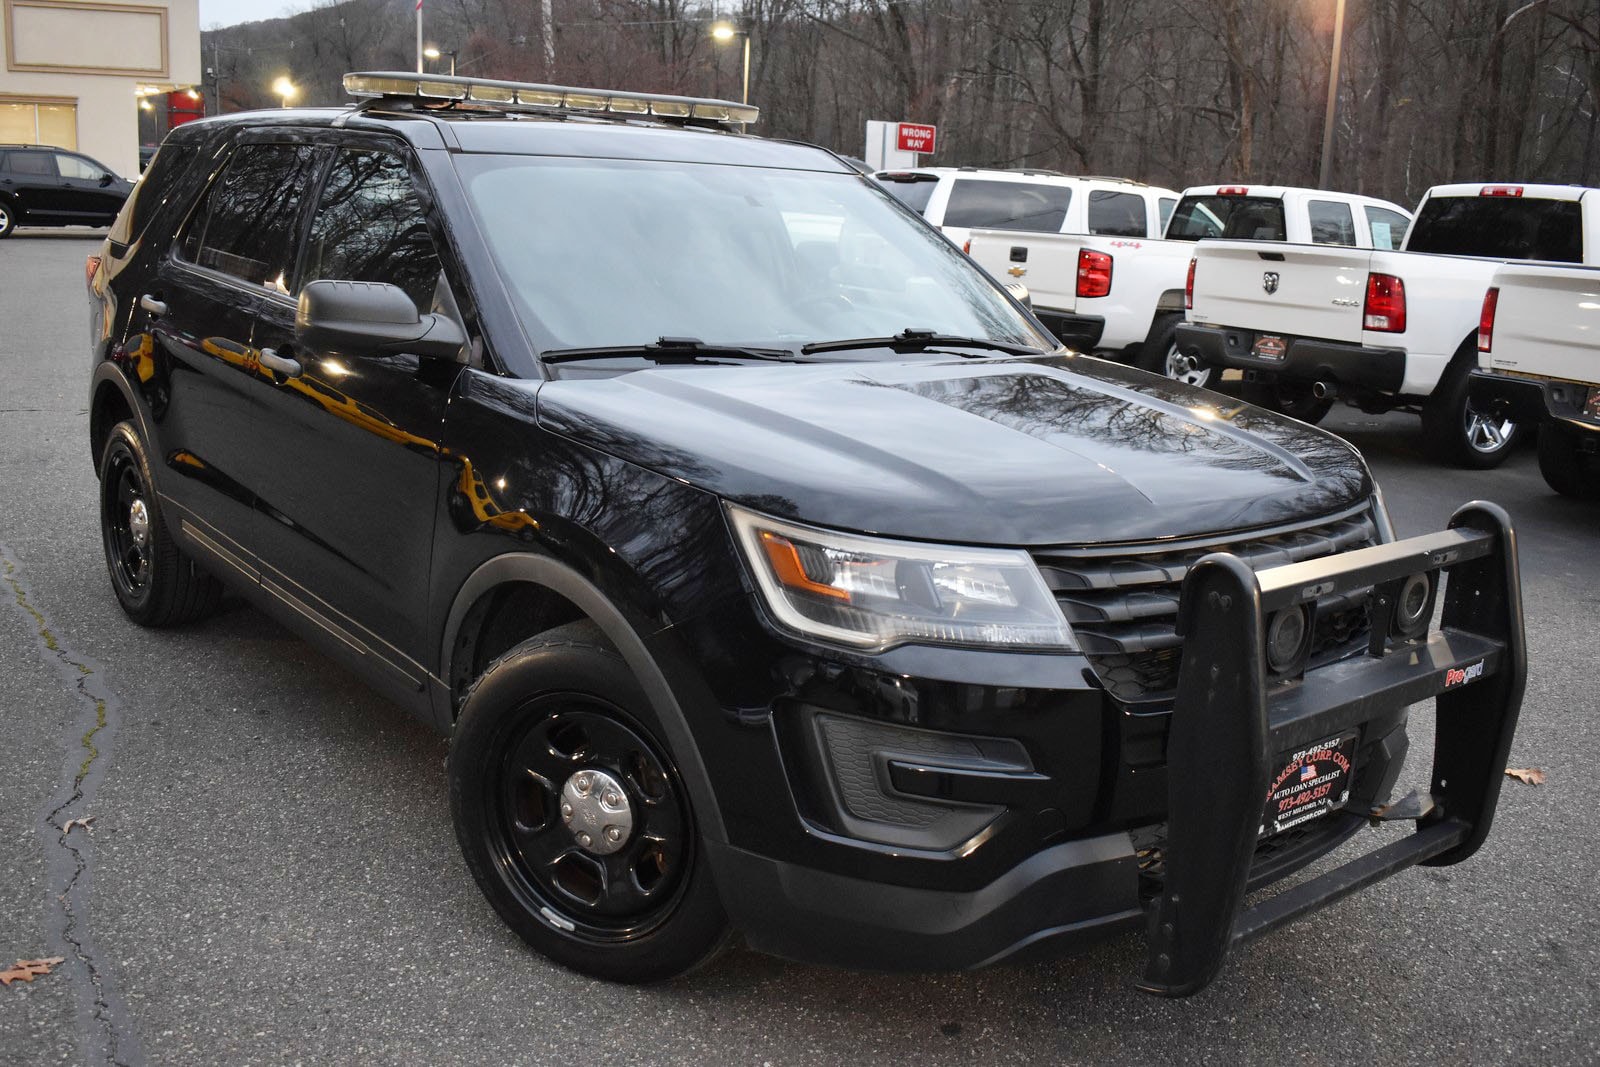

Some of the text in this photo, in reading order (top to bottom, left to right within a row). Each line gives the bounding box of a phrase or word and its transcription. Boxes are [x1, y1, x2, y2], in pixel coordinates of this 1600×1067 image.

[902, 127, 932, 139] WRONG
[907, 138, 925, 149] WAY
[1292, 738, 1340, 761] 973-492-5157
[1333, 752, 1350, 774] COM
[1273, 770, 1341, 801] AUTO LOAN SPECIALIST
[1278, 783, 1331, 812] 973-492-5157
[1278, 810, 1292, 821] WEST
